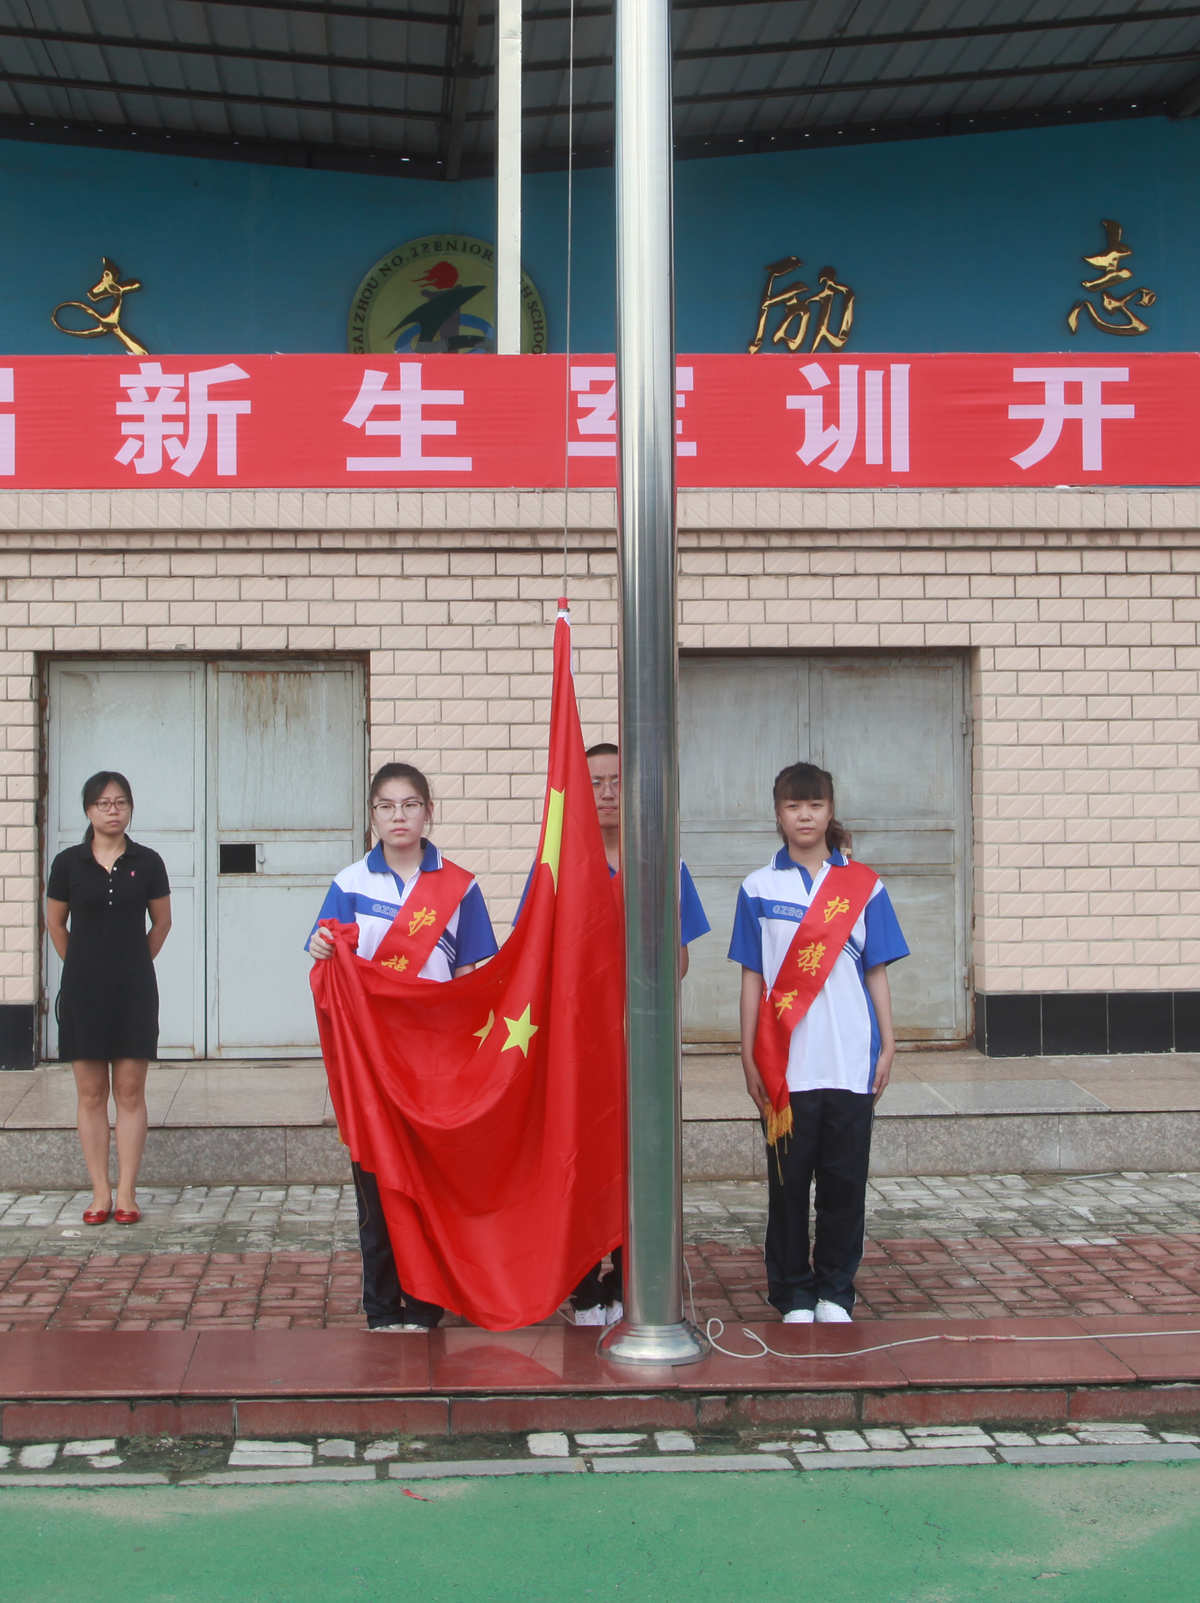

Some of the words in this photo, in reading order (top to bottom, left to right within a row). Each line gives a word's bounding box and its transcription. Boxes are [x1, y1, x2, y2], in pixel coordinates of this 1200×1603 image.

[421, 239, 494, 262] SENIOR
[528, 300, 545, 355] SCHOO
[0, 361, 1137, 478] 新生军训开
[775, 896, 850, 1020] 护旗手
